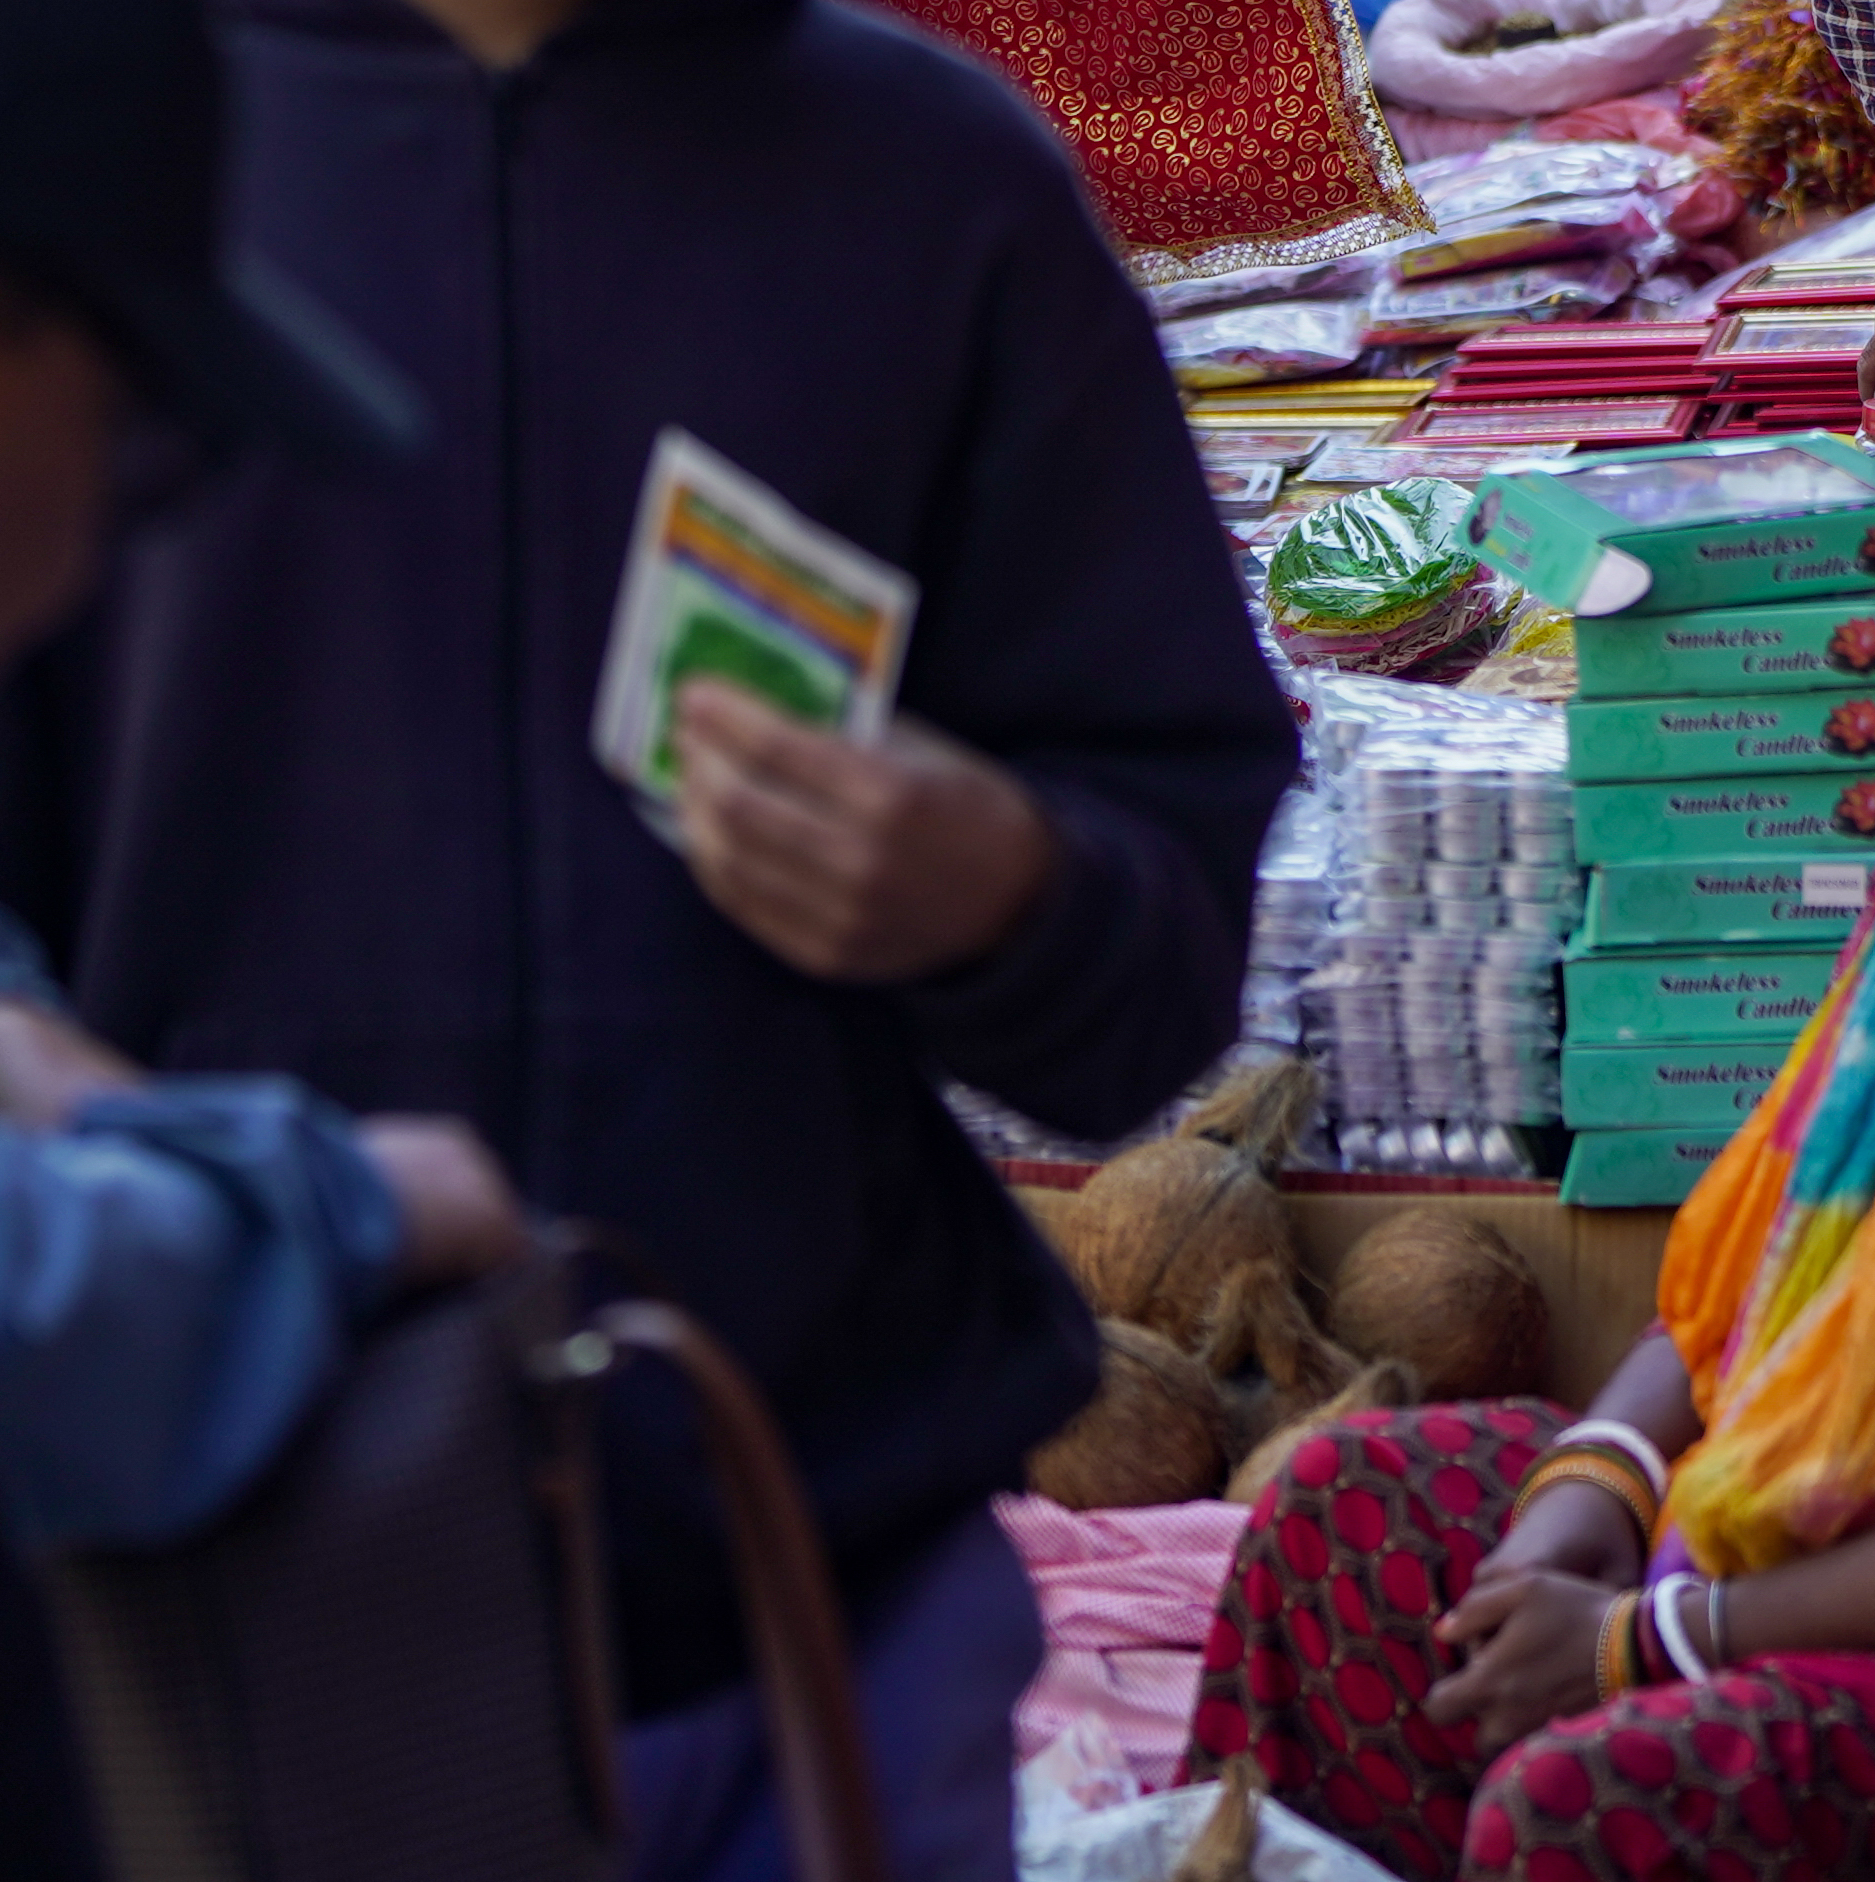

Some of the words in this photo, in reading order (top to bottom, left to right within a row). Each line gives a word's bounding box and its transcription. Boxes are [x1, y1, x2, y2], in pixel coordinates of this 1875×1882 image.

[1697, 534, 1816, 563] Smokeless
[1772, 557, 1867, 582] Candles
[1664, 628, 1783, 650] Smokeless
[1742, 651, 1836, 674] Candles
[1658, 710, 1779, 733] Smokeless
[1736, 734, 1834, 757] Candles
[1668, 792, 1790, 815] Smokeless
[1745, 815, 1841, 839] Candles
[1692, 873, 1803, 896] Smokeles
[1657, 972, 1781, 995] Smokeless
[1736, 996, 1819, 1020] Candle
[1654, 1062, 1779, 1085] Smokeless
